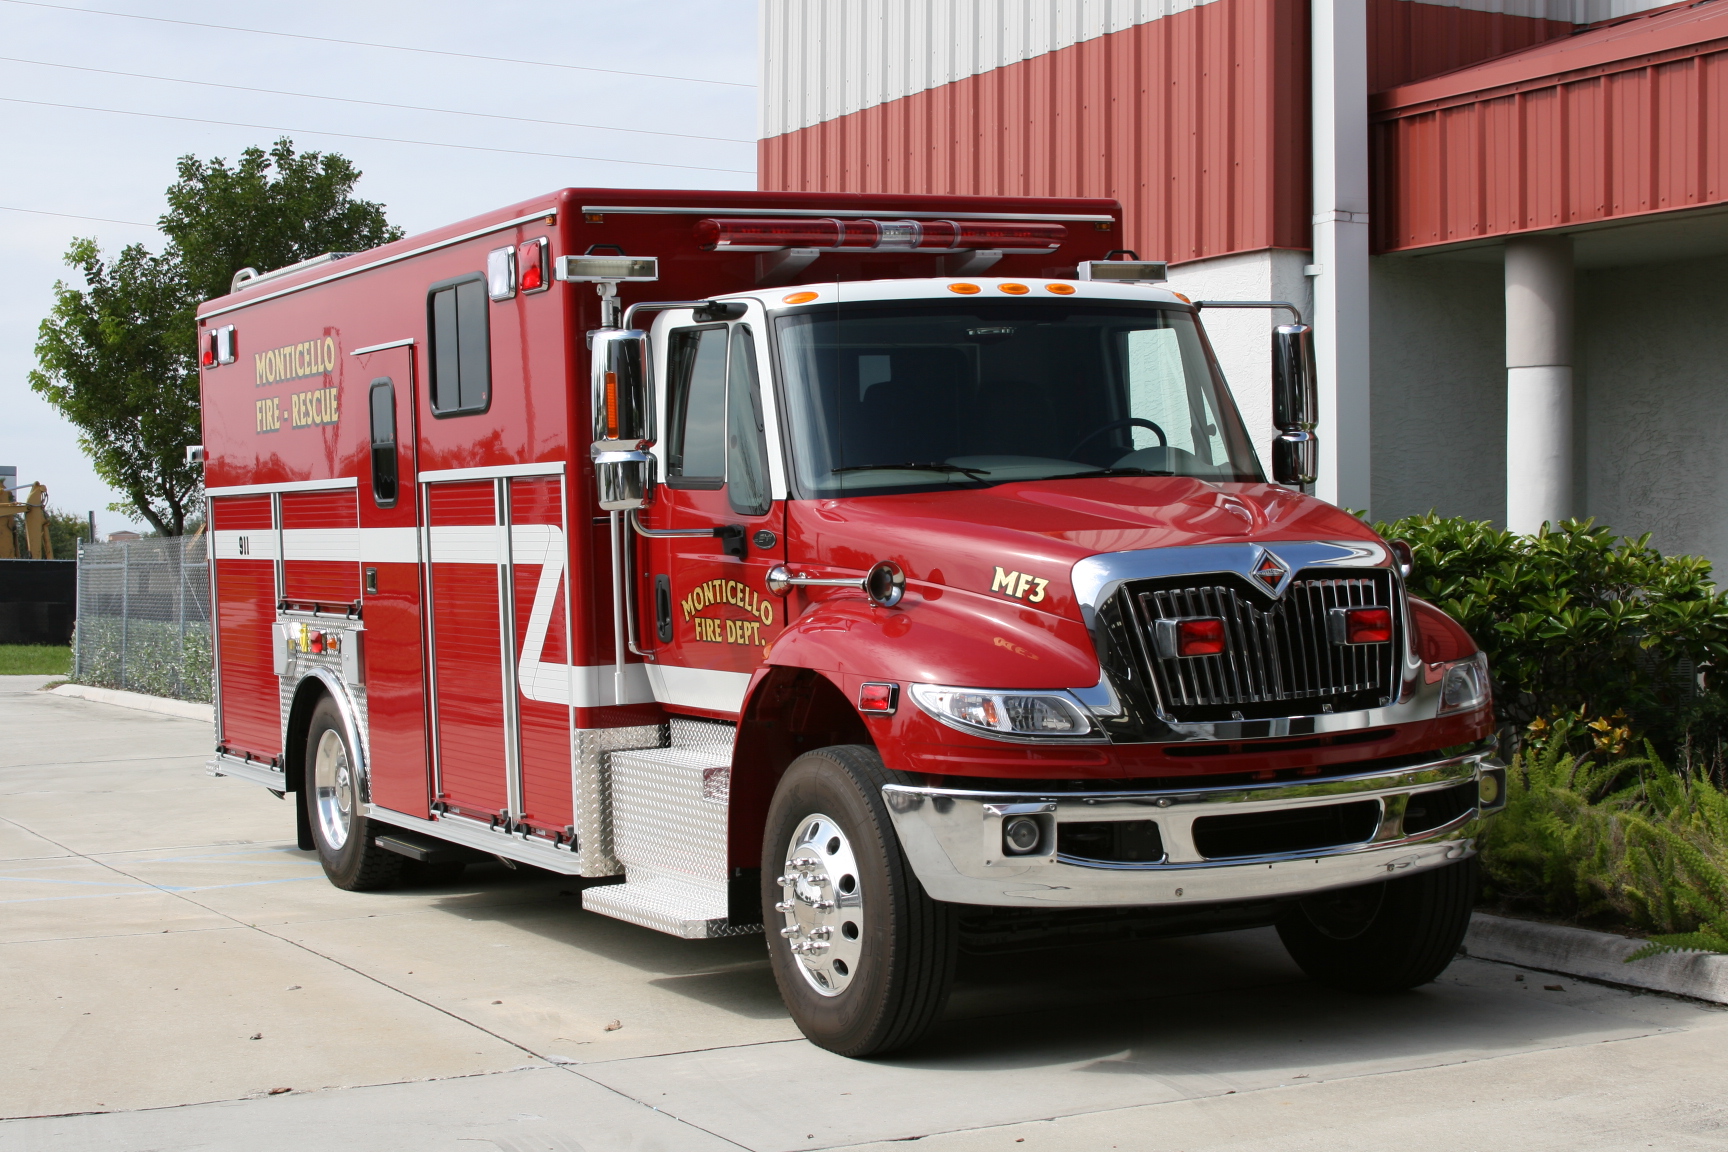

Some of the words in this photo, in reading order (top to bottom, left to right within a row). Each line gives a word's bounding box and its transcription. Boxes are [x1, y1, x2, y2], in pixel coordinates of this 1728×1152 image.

[255, 336, 335, 386] MONTICELLO
[255, 397, 280, 433] FIRE
[291, 387, 339, 429] RESCUE
[239, 535, 250, 555] 911
[681, 579, 773, 627] MONTICELLO
[991, 566, 1050, 603] MF3
[694, 617, 723, 642] FIRE
[725, 619, 766, 647] DEPT.
